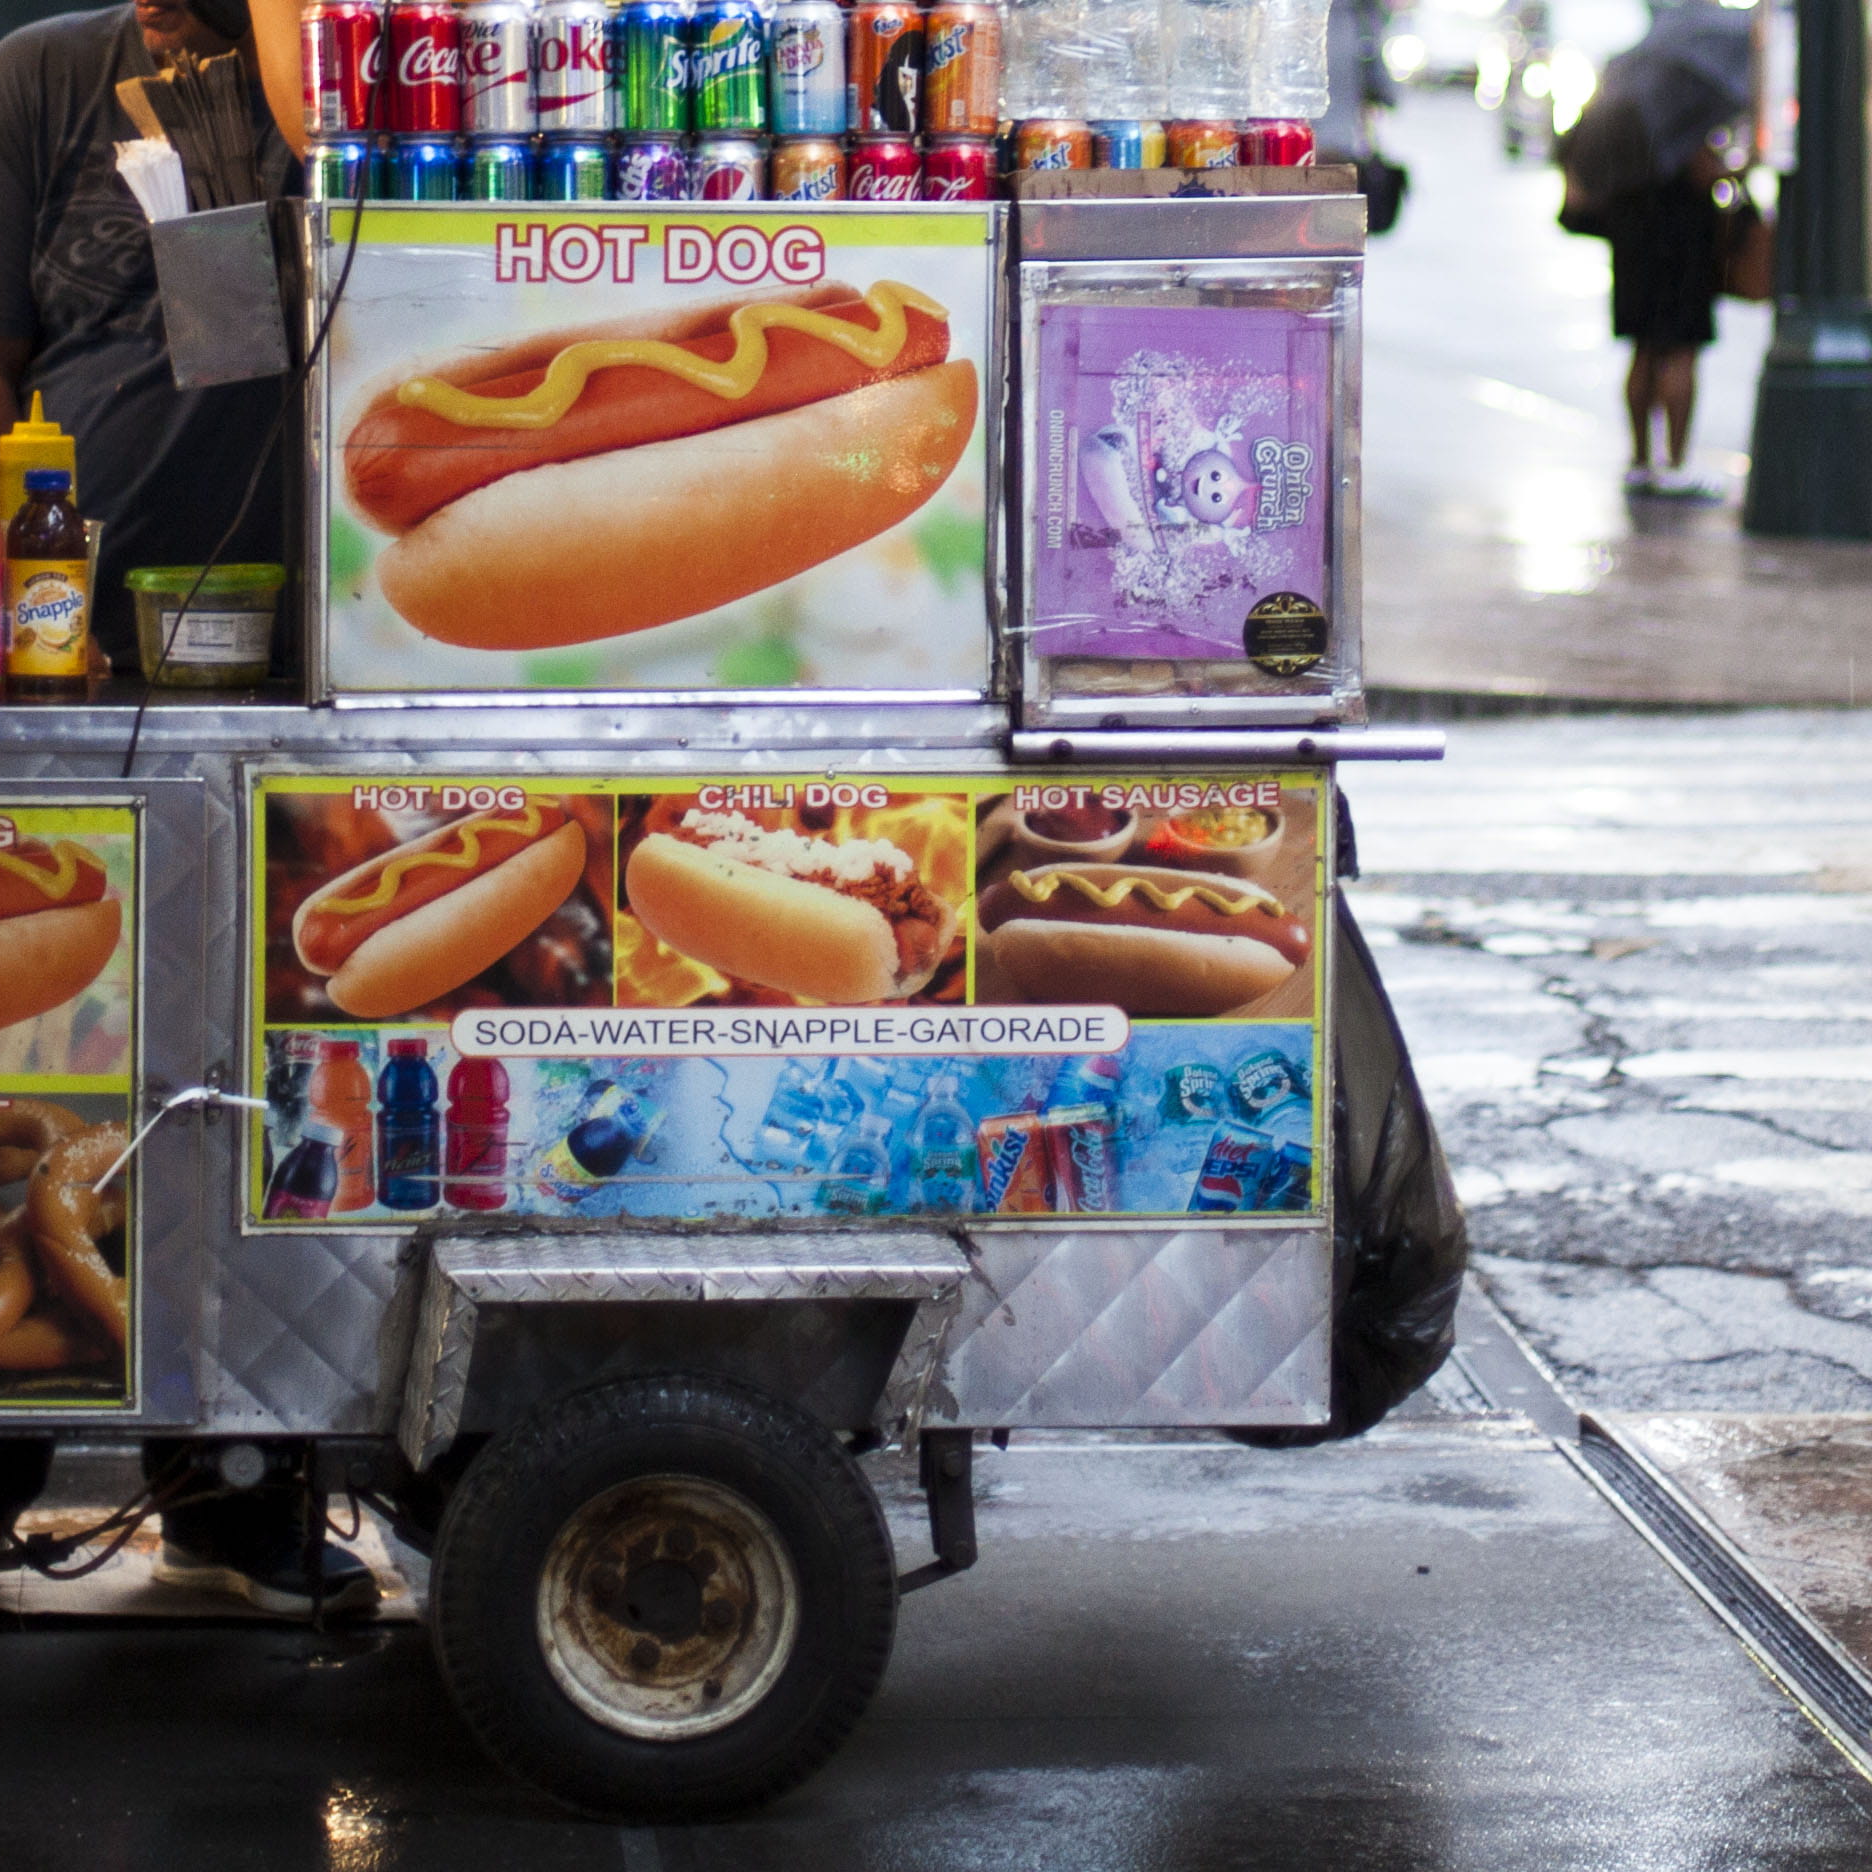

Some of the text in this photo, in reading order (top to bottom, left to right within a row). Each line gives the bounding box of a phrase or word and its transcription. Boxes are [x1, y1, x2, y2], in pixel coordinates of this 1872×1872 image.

[540, 24, 627, 74] oke
[690, 35, 762, 90] Sprite
[496, 223, 825, 285] HOT DOG
[1251, 436, 1284, 534] Crunch
[1281, 440, 1314, 528] Onion
[17, 590, 84, 624] Snapple
[352, 784, 525, 811] HOT DOG
[697, 783, 889, 810] CHILI DOG
[1015, 782, 1280, 811] HOT SAUSAGE
[475, 1016, 1105, 1047] SODA-WATER-SNAPPLE-GATORADE
